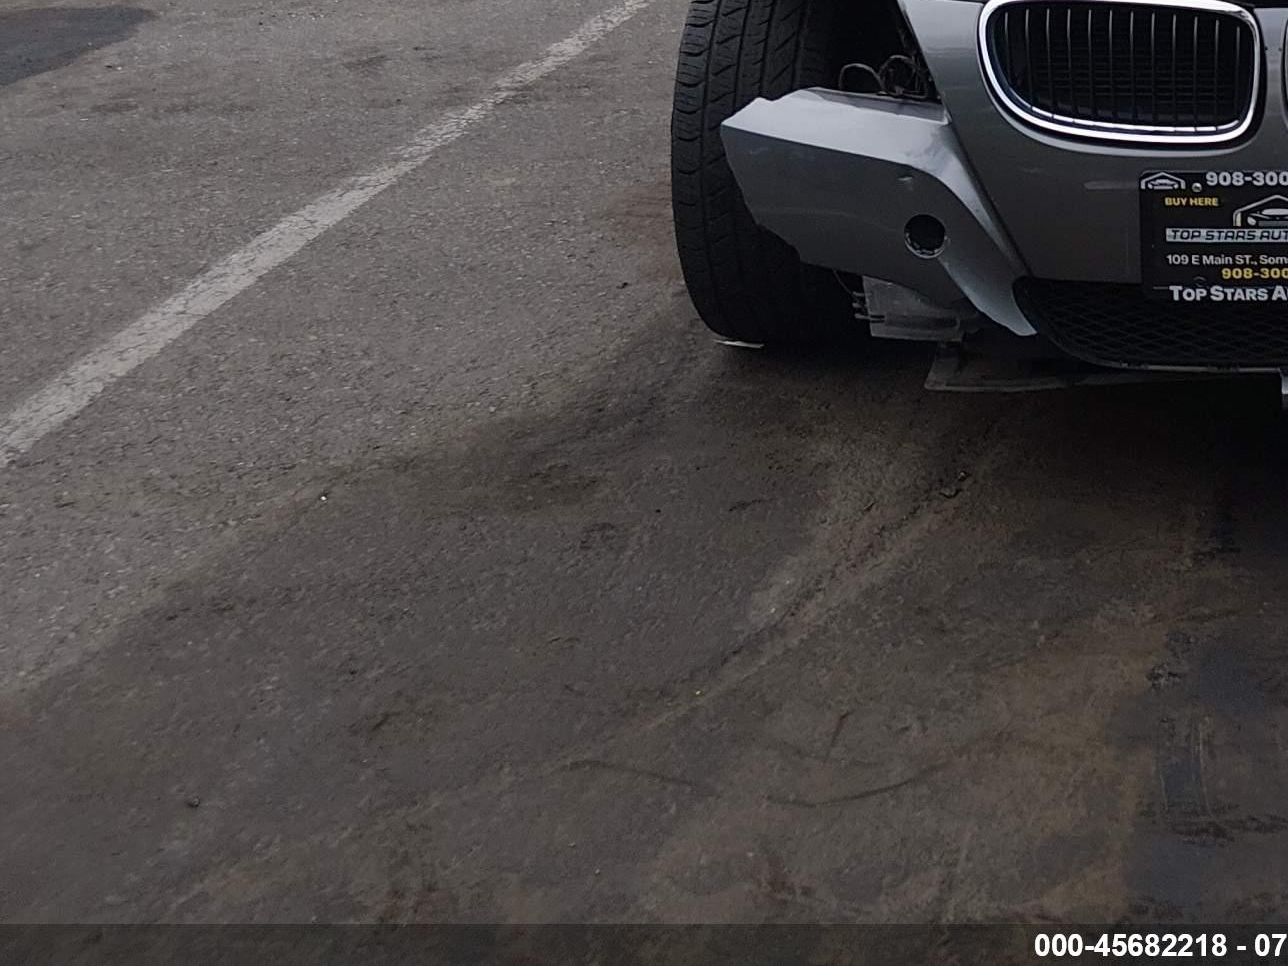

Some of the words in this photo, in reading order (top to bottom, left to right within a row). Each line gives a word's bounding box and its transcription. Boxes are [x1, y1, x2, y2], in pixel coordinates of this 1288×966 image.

[1164, 197, 1188, 206] BUY
[1189, 197, 1219, 206] HERE
[1171, 229, 1202, 240] TOP
[1205, 229, 1257, 240] STARS
[1166, 254, 1189, 265] 109
[1191, 255, 1200, 265] E
[1202, 254, 1233, 265] Main
